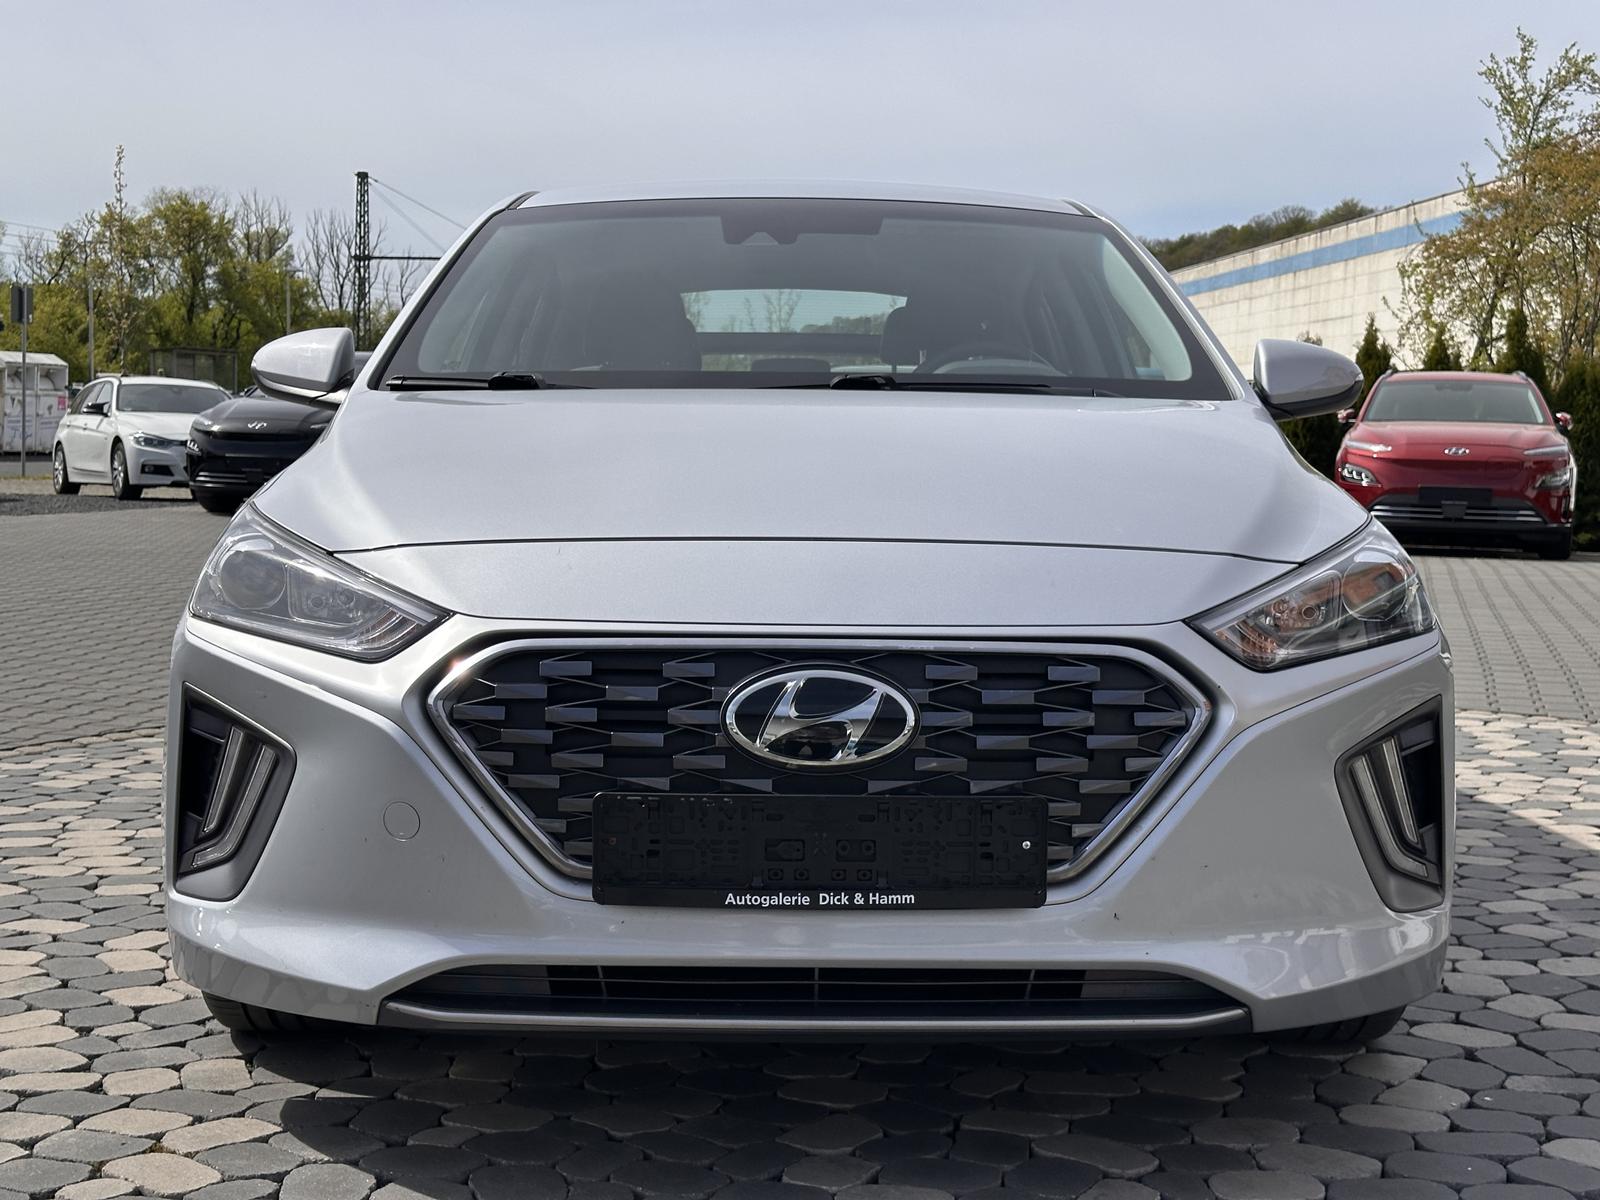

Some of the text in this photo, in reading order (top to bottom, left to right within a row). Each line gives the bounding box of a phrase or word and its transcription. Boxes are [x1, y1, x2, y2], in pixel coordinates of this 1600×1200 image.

[725, 892, 915, 907] Autogalerie Dick & Hamm
